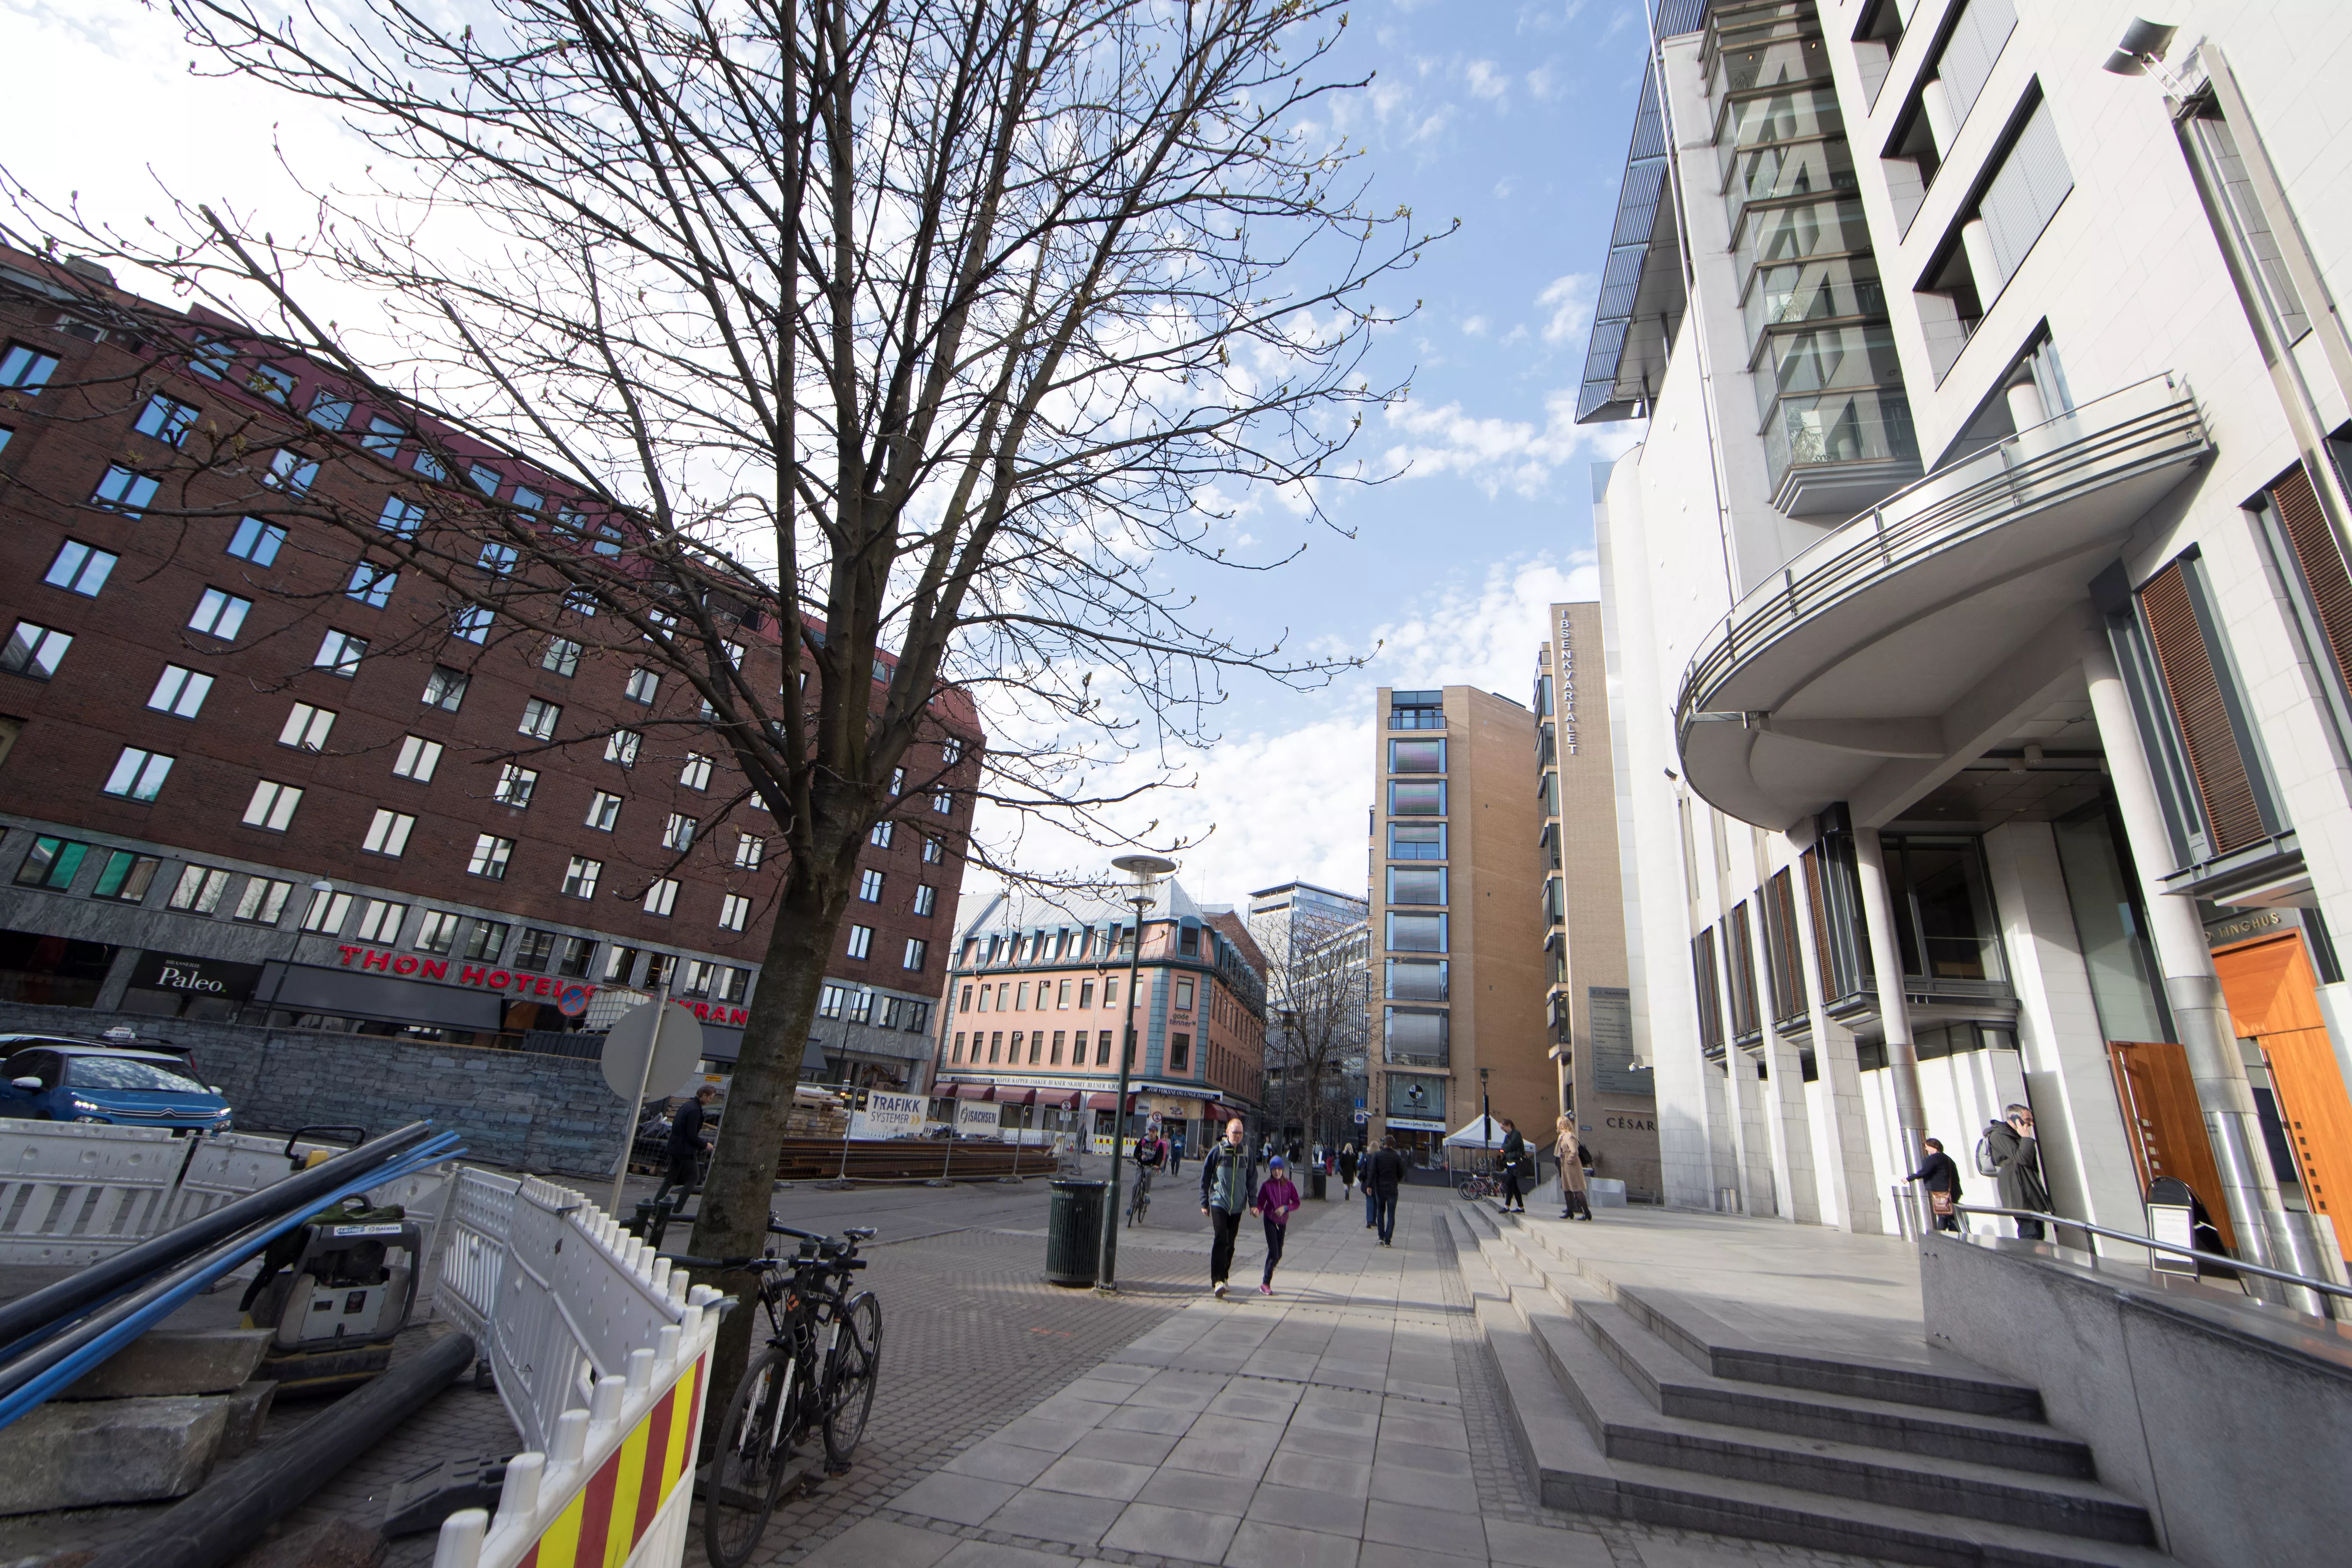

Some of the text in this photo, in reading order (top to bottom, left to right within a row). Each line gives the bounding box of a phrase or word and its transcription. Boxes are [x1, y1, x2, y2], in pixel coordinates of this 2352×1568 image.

[1560, 609, 1577, 755] IBSENKVARTALET
[2218, 912, 2280, 938] TINGHUS
[165, 959, 202, 968] BRASSERIE
[339, 945, 449, 980] THON
[1170, 1018, 1192, 1027] tenner
[873, 1095, 921, 1113] TRAFIKK
[871, 1111, 910, 1124] SYSTEMER
[968, 1110, 996, 1124] ISACHSEN
